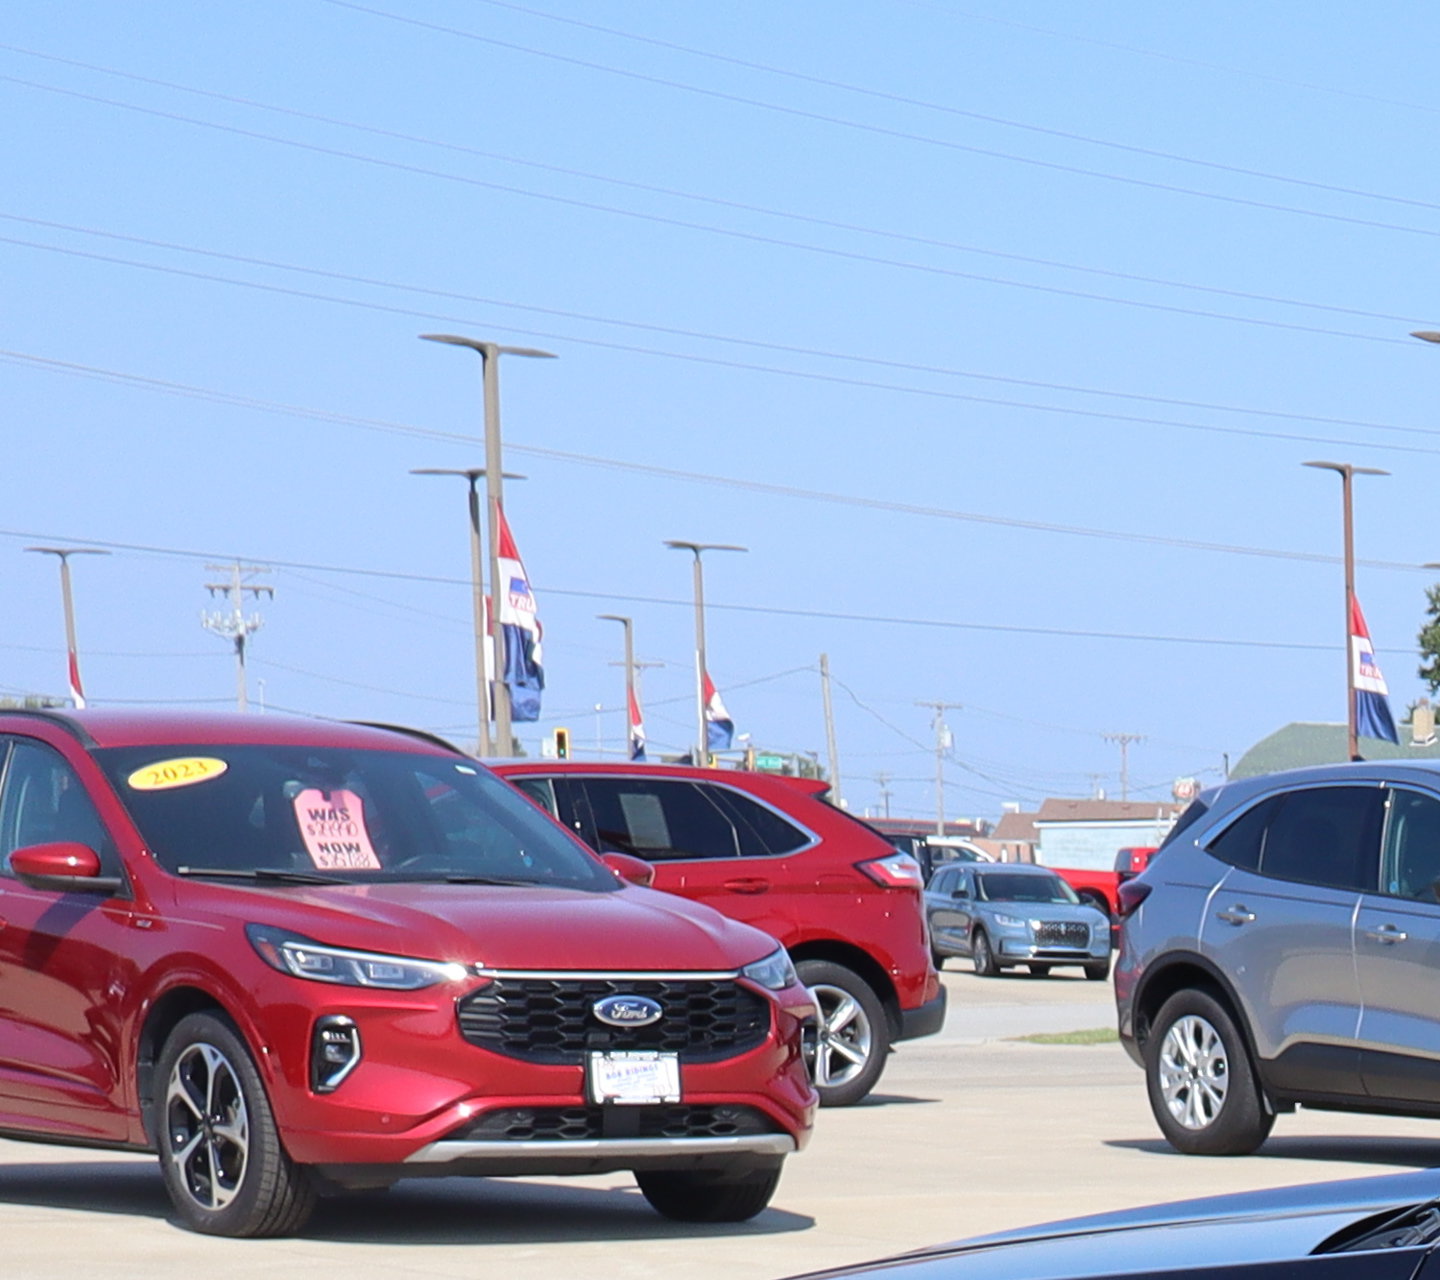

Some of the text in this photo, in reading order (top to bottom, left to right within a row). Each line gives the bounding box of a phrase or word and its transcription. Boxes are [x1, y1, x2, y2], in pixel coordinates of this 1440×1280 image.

[147, 761, 208, 785] 2023
[308, 807, 350, 821] WAS
[318, 842, 361, 854] NOW
